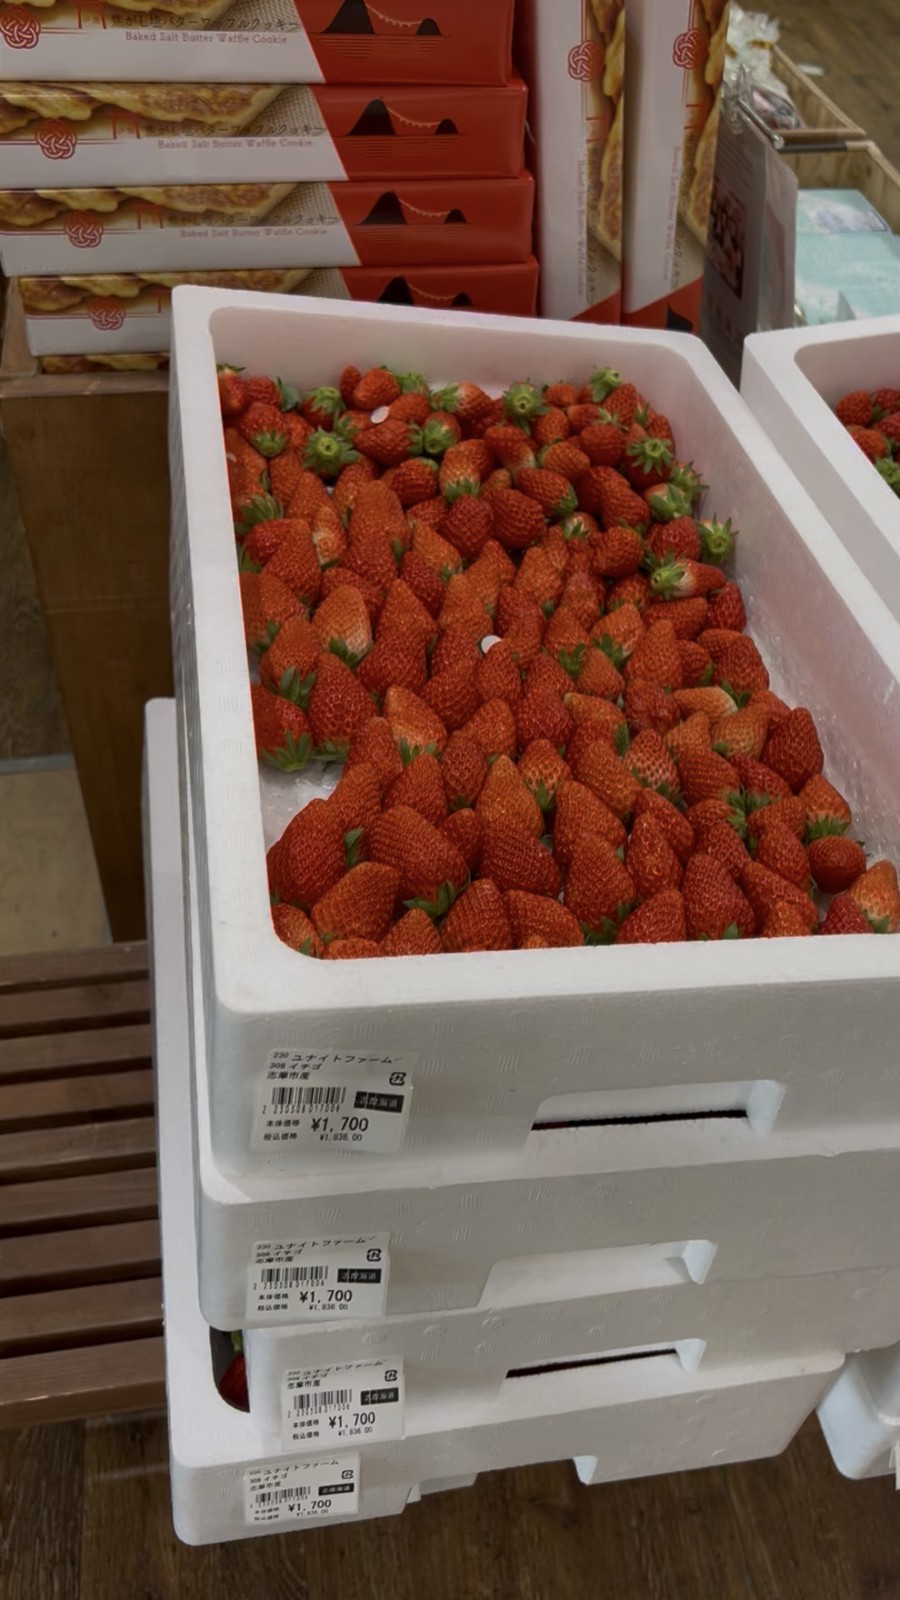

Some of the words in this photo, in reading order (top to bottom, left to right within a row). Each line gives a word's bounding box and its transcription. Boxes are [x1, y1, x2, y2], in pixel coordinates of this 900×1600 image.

[125, 31, 156, 41] Baked
[159, 31, 180, 42] Salt
[182, 32, 213, 42] Butter
[217, 33, 249, 43] Waffle
[252, 34, 288, 44] Cookie
[266, 1071, 311, 1080] 志摩市産
[310, 1116, 369, 1132] ¥1,700
[263, 1133, 298, 1141] 税込価格
[273, 1249, 303, 1257] イチゴ
[258, 1293, 289, 1301] 本体価格
[299, 1290, 353, 1303] ¥1,700
[287, 1379, 321, 1390] 志摩市産
[292, 1419, 320, 1429] 本体価格
[328, 1411, 375, 1429] ¥1,700
[292, 1431, 320, 1441] 税込価格
[288, 1499, 332, 1513] ¥1,700
